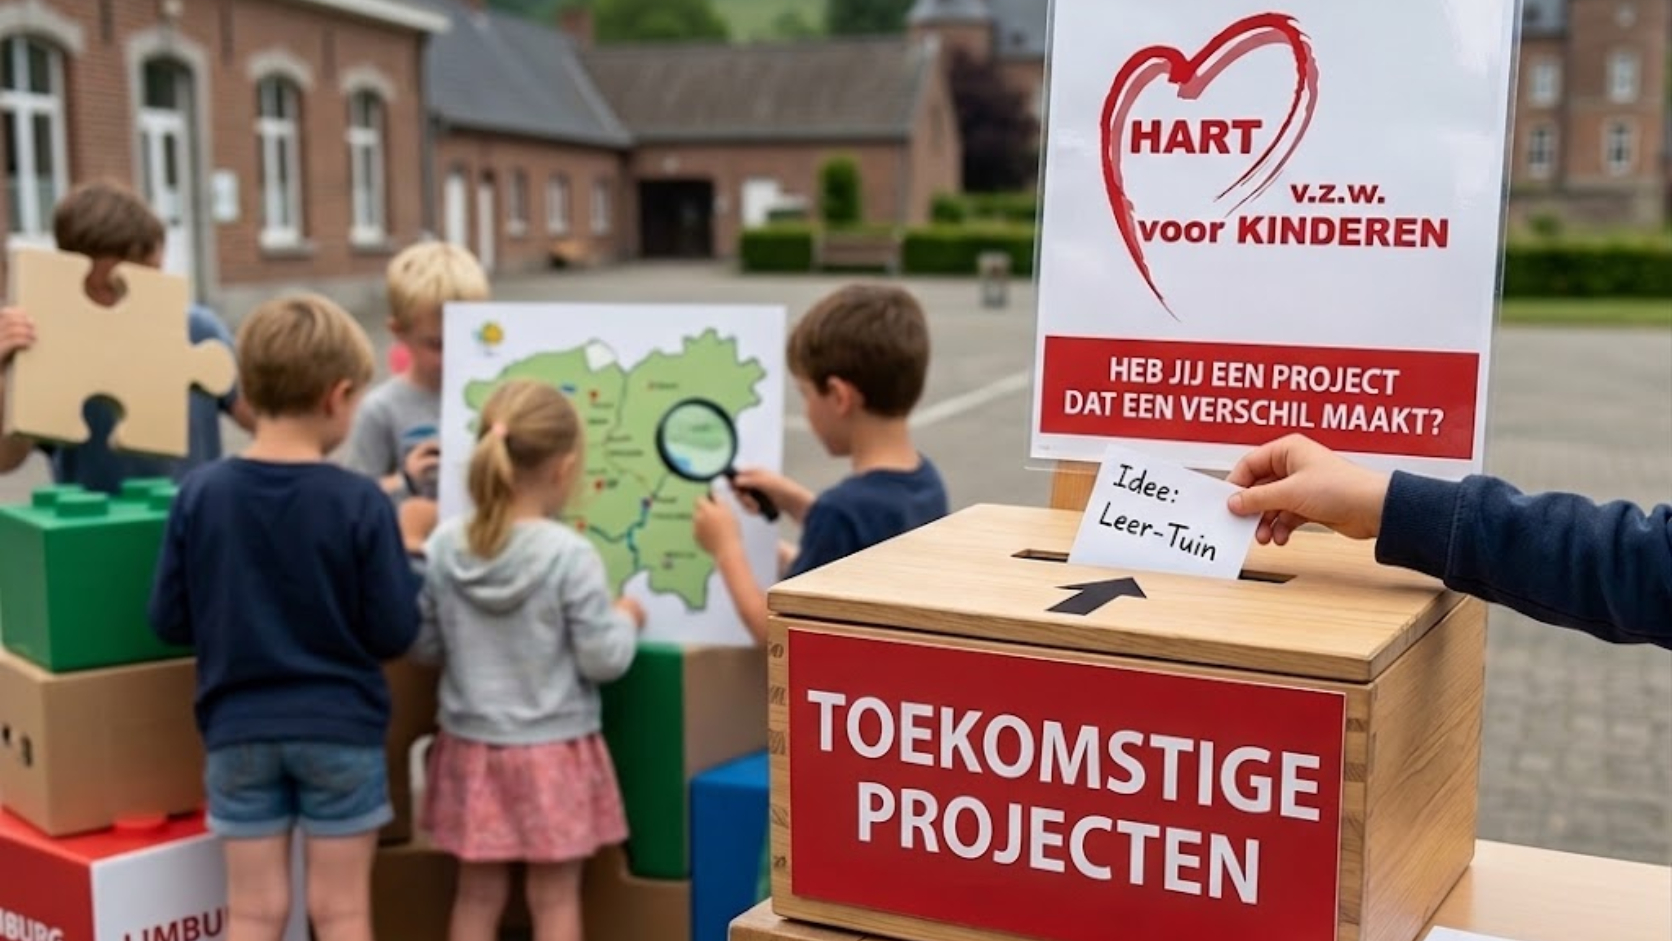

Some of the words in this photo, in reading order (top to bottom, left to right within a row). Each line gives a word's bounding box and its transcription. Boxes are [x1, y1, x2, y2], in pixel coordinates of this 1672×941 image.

[1131, 119, 1261, 153] HART
[1291, 185, 1386, 204] v.z.w.
[1138, 220, 1225, 244] voor
[1238, 217, 1447, 247] KINDEREN
[1111, 357, 1162, 382] HEB
[1169, 360, 1203, 385] JIJ
[1212, 362, 1263, 387] EEN
[1273, 365, 1399, 394] PROJECT
[1065, 391, 1116, 415] DAT
[1124, 393, 1173, 419] EEN
[1181, 396, 1314, 427] VERSCHIL
[1322, 404, 1443, 434] MAAKT?
[1112, 463, 1180, 503] Idee:
[1100, 502, 1215, 560] Leer-Tuin
[807, 689, 1321, 821] TOEKOMSTIGE
[857, 781, 1260, 905] PROJECTEN
